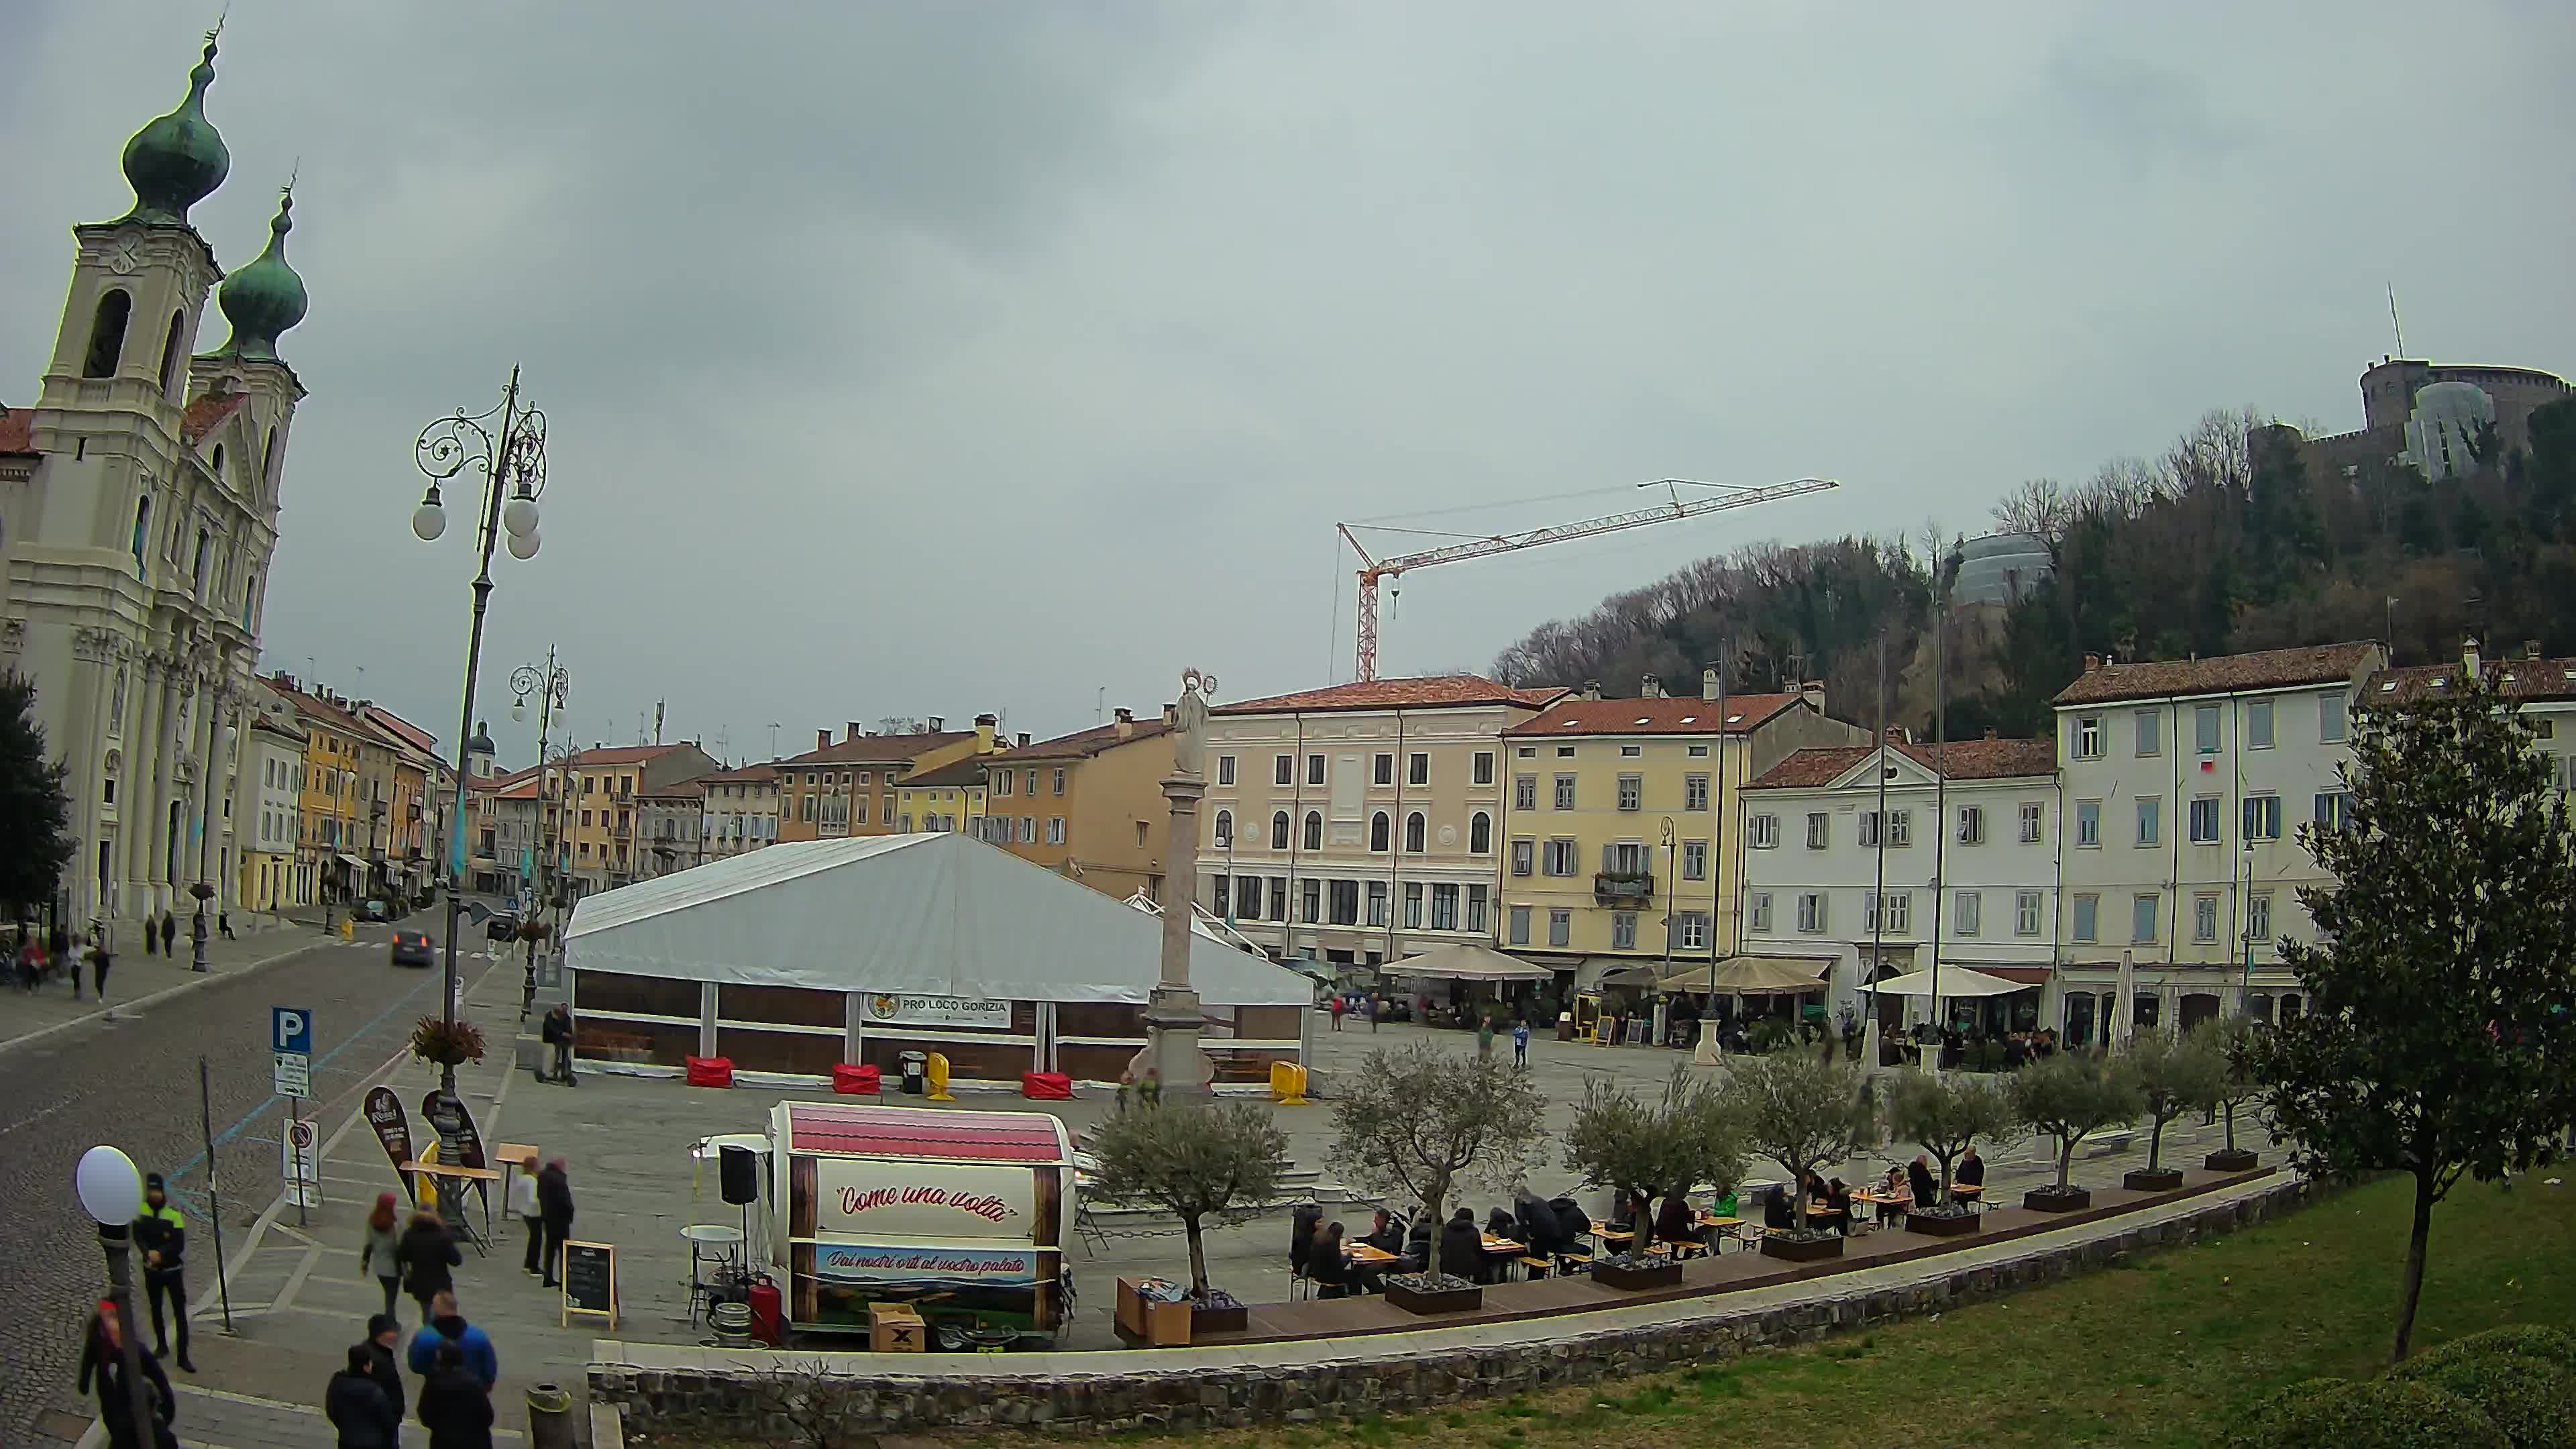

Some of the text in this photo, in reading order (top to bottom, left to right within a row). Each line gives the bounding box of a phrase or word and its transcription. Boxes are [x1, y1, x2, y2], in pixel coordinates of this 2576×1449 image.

[903, 1000, 1006, 1012] PRO LOCO GORIZIA
[279, 1011, 303, 1046] P
[901, 1186, 947, 1205] una
[827, 1250, 1024, 1277] Dai nostri orti al vostro palato
